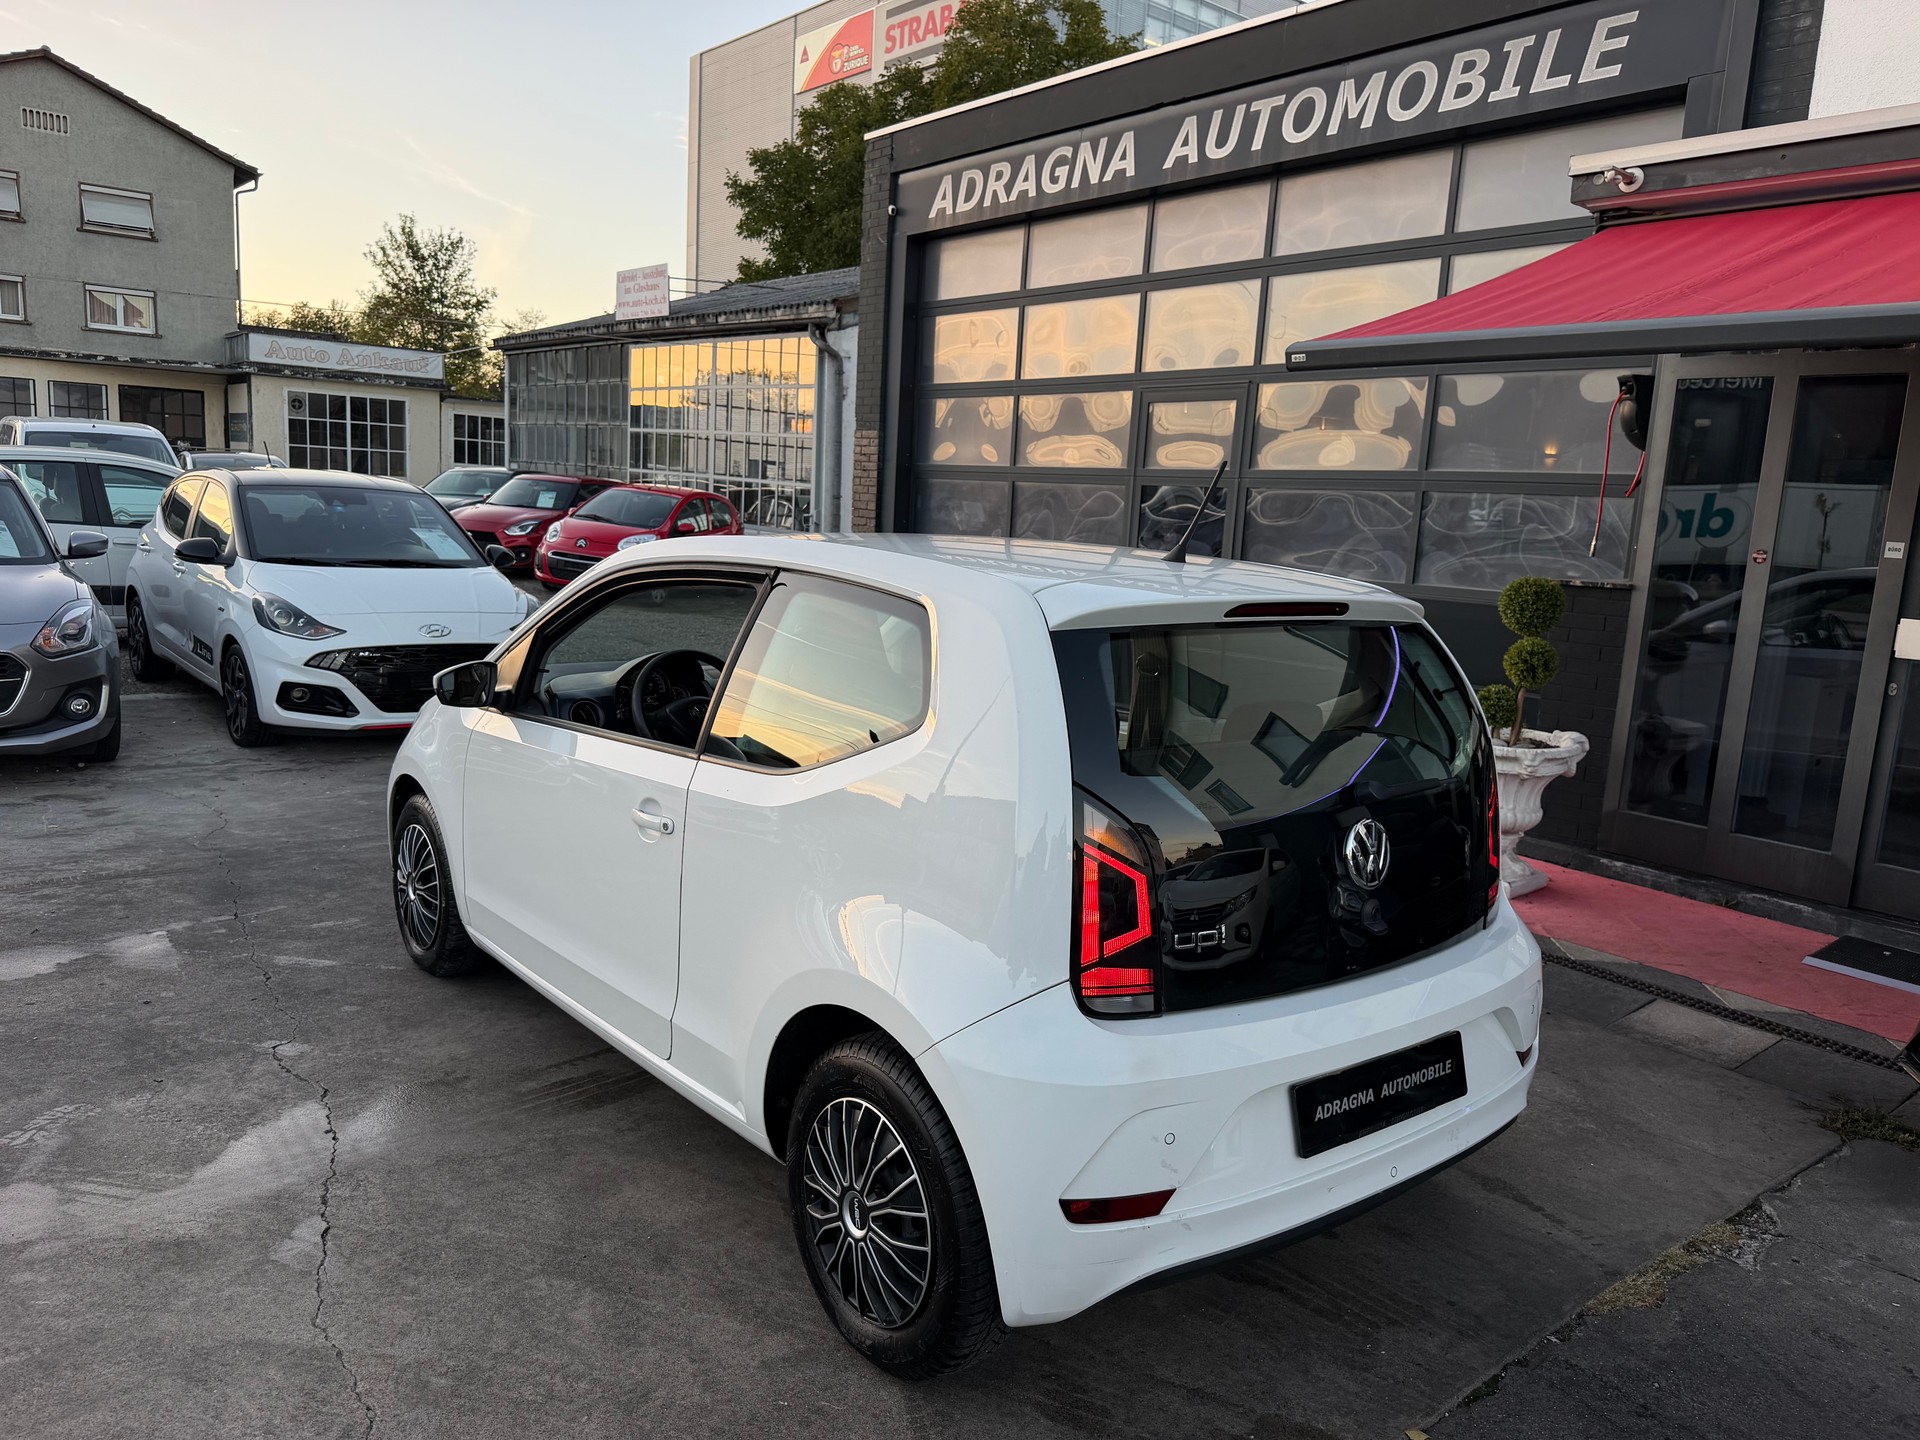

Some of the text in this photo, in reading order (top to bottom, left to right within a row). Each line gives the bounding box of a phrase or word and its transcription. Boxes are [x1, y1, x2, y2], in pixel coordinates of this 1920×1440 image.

[843, 55, 869, 72] ZURIQUE
[928, 10, 1640, 219] ADRAGNA AUTOMOBILE
[633, 281, 660, 294] Glashaus
[265, 339, 430, 373] Auto Ankauf
[1314, 1088, 1375, 1122] ADRAGNA
[1381, 1059, 1452, 1098] AUTOMOBILE
